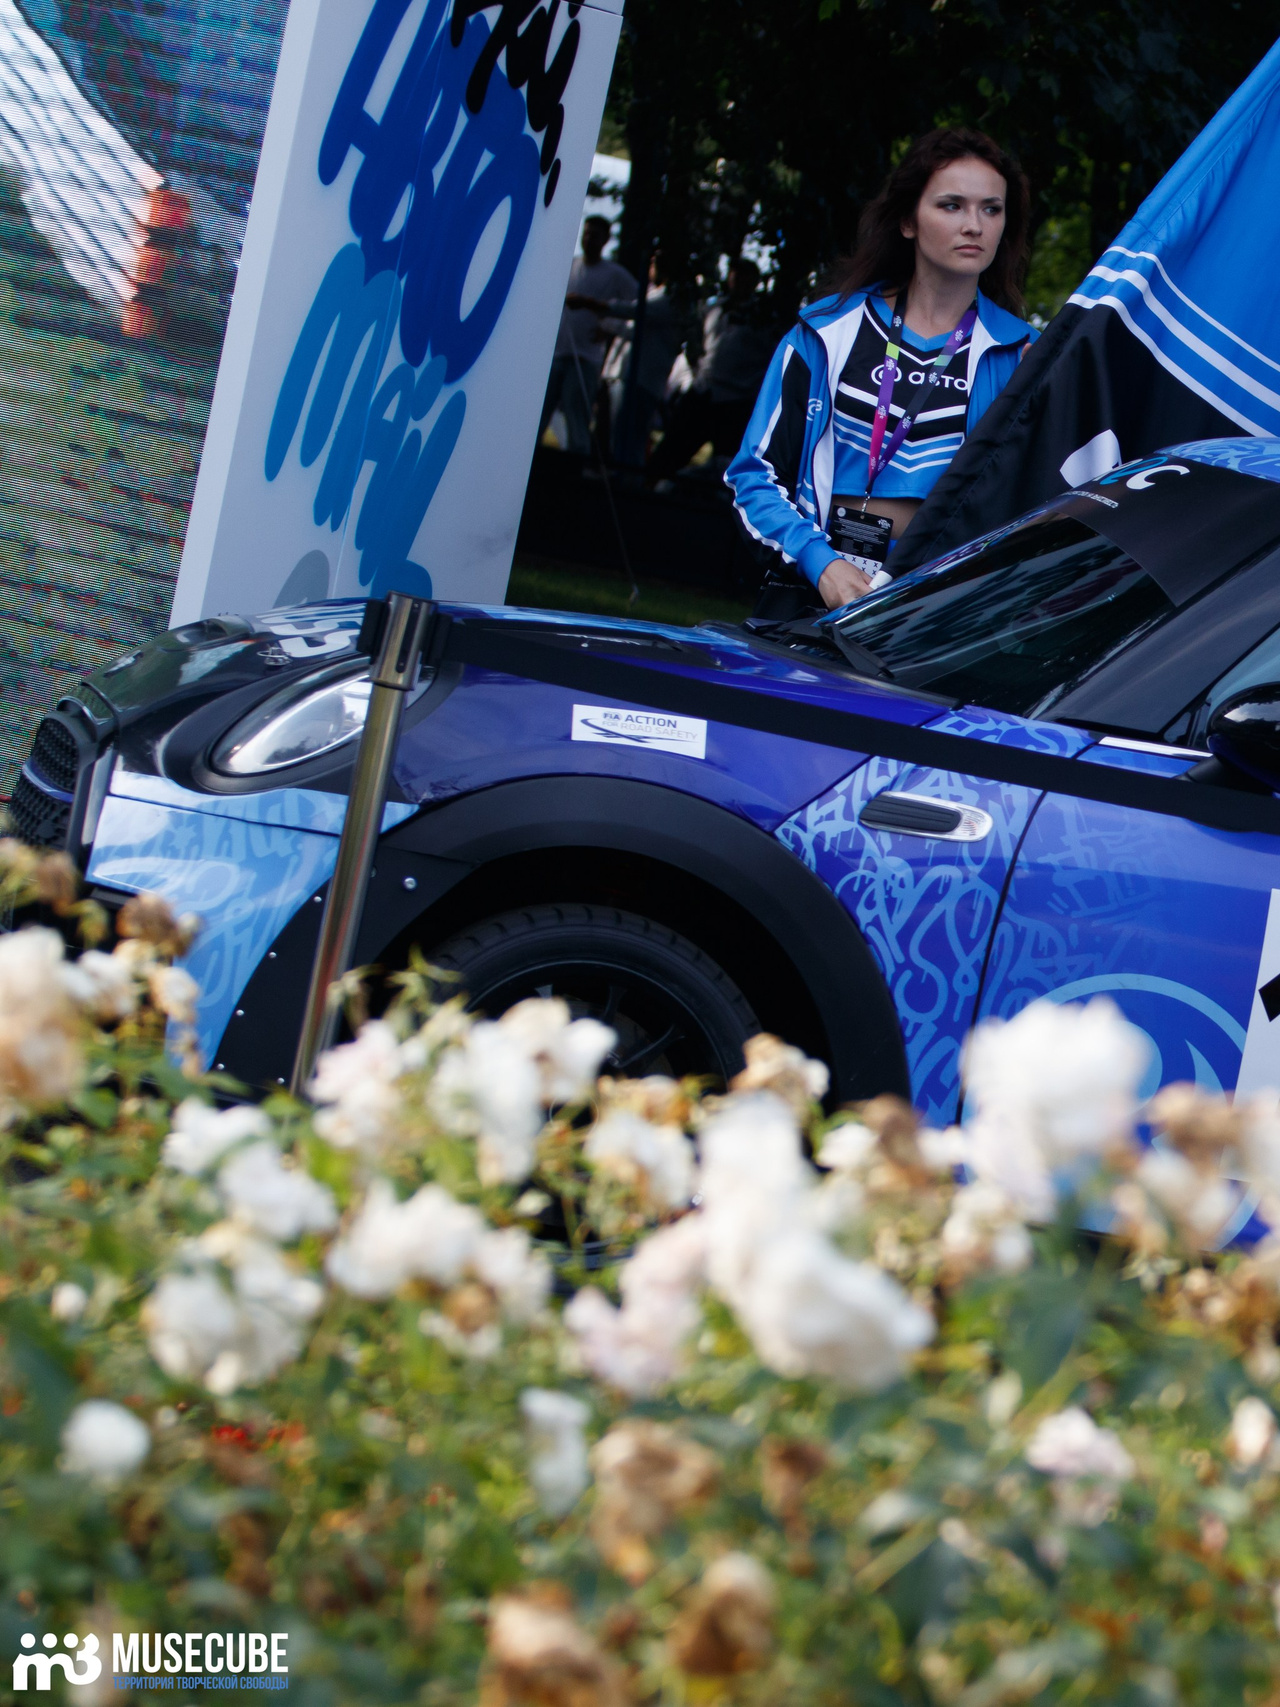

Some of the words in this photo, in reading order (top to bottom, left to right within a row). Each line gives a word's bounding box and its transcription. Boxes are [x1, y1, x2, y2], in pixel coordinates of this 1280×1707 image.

[602, 720, 620, 728] FOR
[620, 720, 652, 734] ROAD
[655, 725, 698, 741] SAFETY
[624, 714, 678, 729] ACTION
